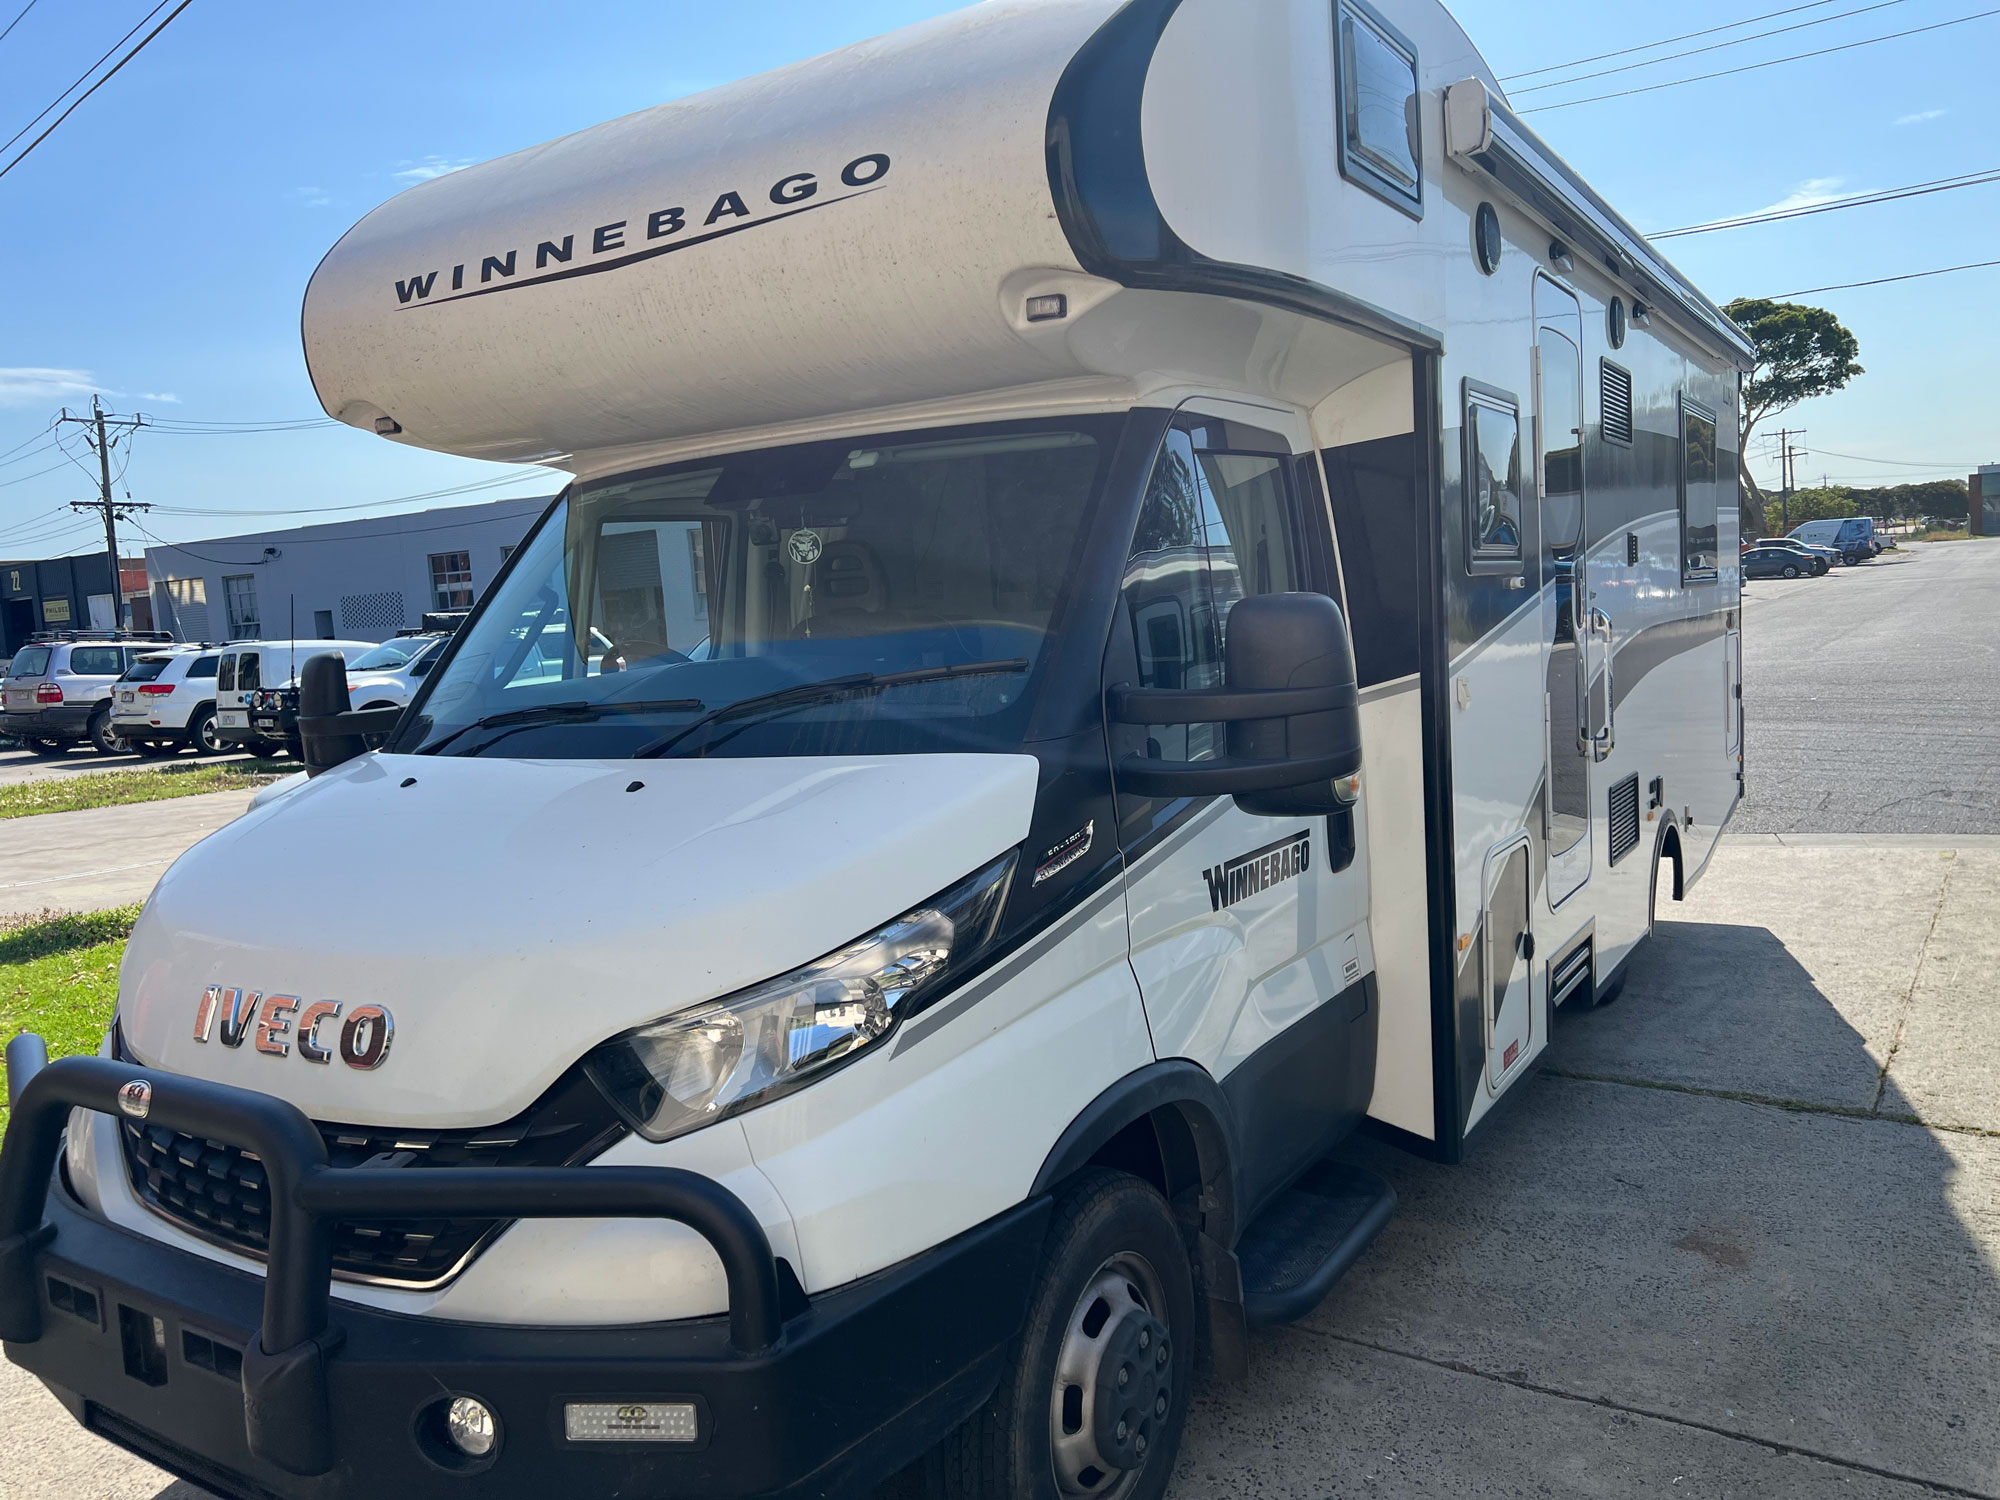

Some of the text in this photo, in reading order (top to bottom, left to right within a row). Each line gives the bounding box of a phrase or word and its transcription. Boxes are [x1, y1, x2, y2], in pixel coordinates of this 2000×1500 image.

[395, 153, 891, 304] WINNEBAGO
[10, 570, 21, 591] 22
[1202, 828, 1310, 912] WINNEBAGO
[194, 984, 395, 1071] IVECO
